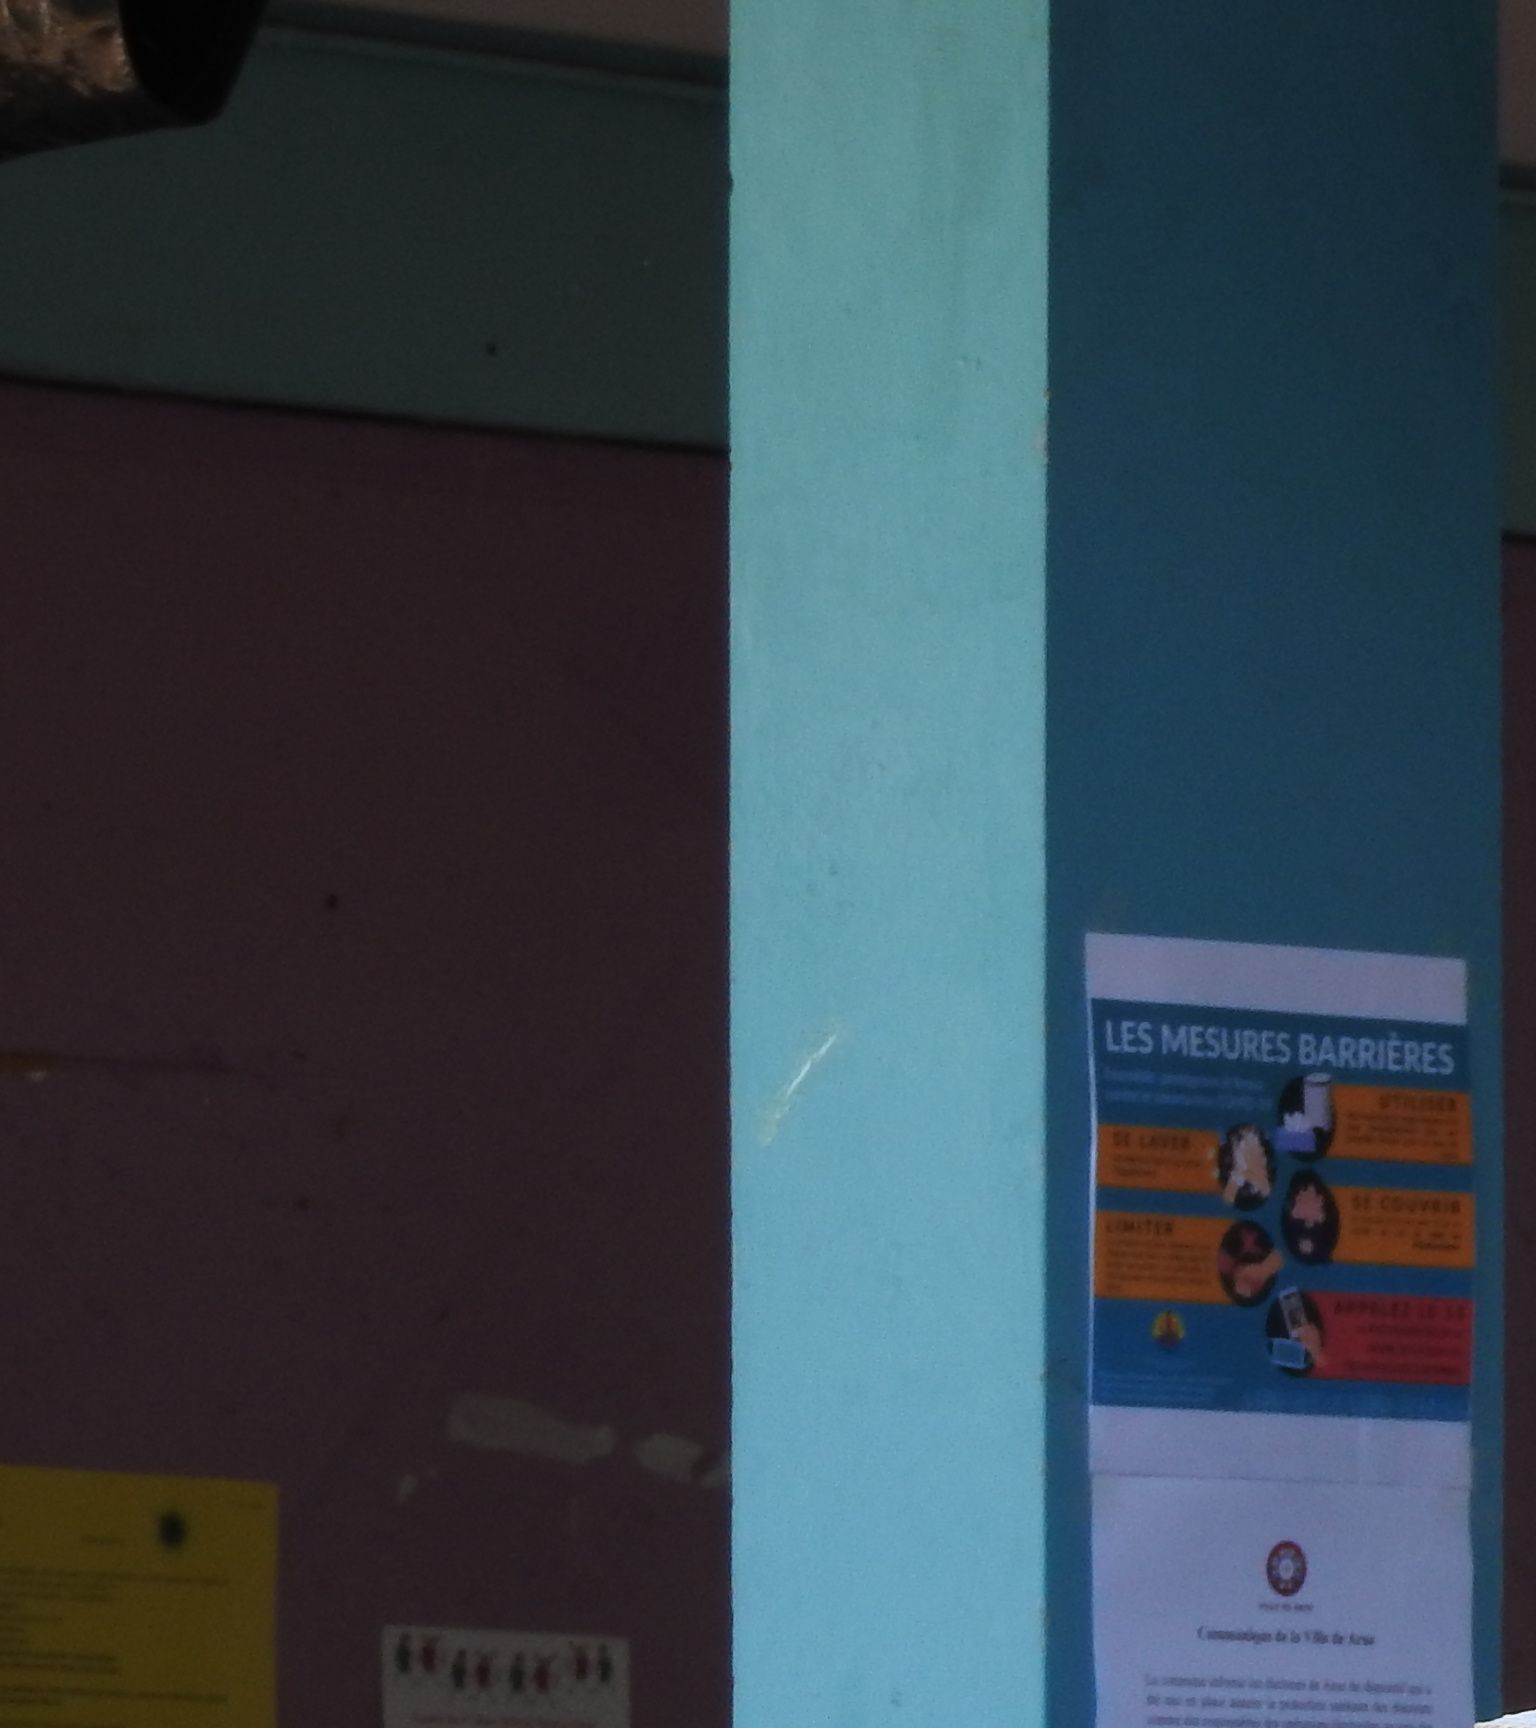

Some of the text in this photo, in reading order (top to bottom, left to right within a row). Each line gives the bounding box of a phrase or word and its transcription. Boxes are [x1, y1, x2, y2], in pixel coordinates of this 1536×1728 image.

[1105, 1019, 1456, 1076] LES MESURES BARRIÈRES
